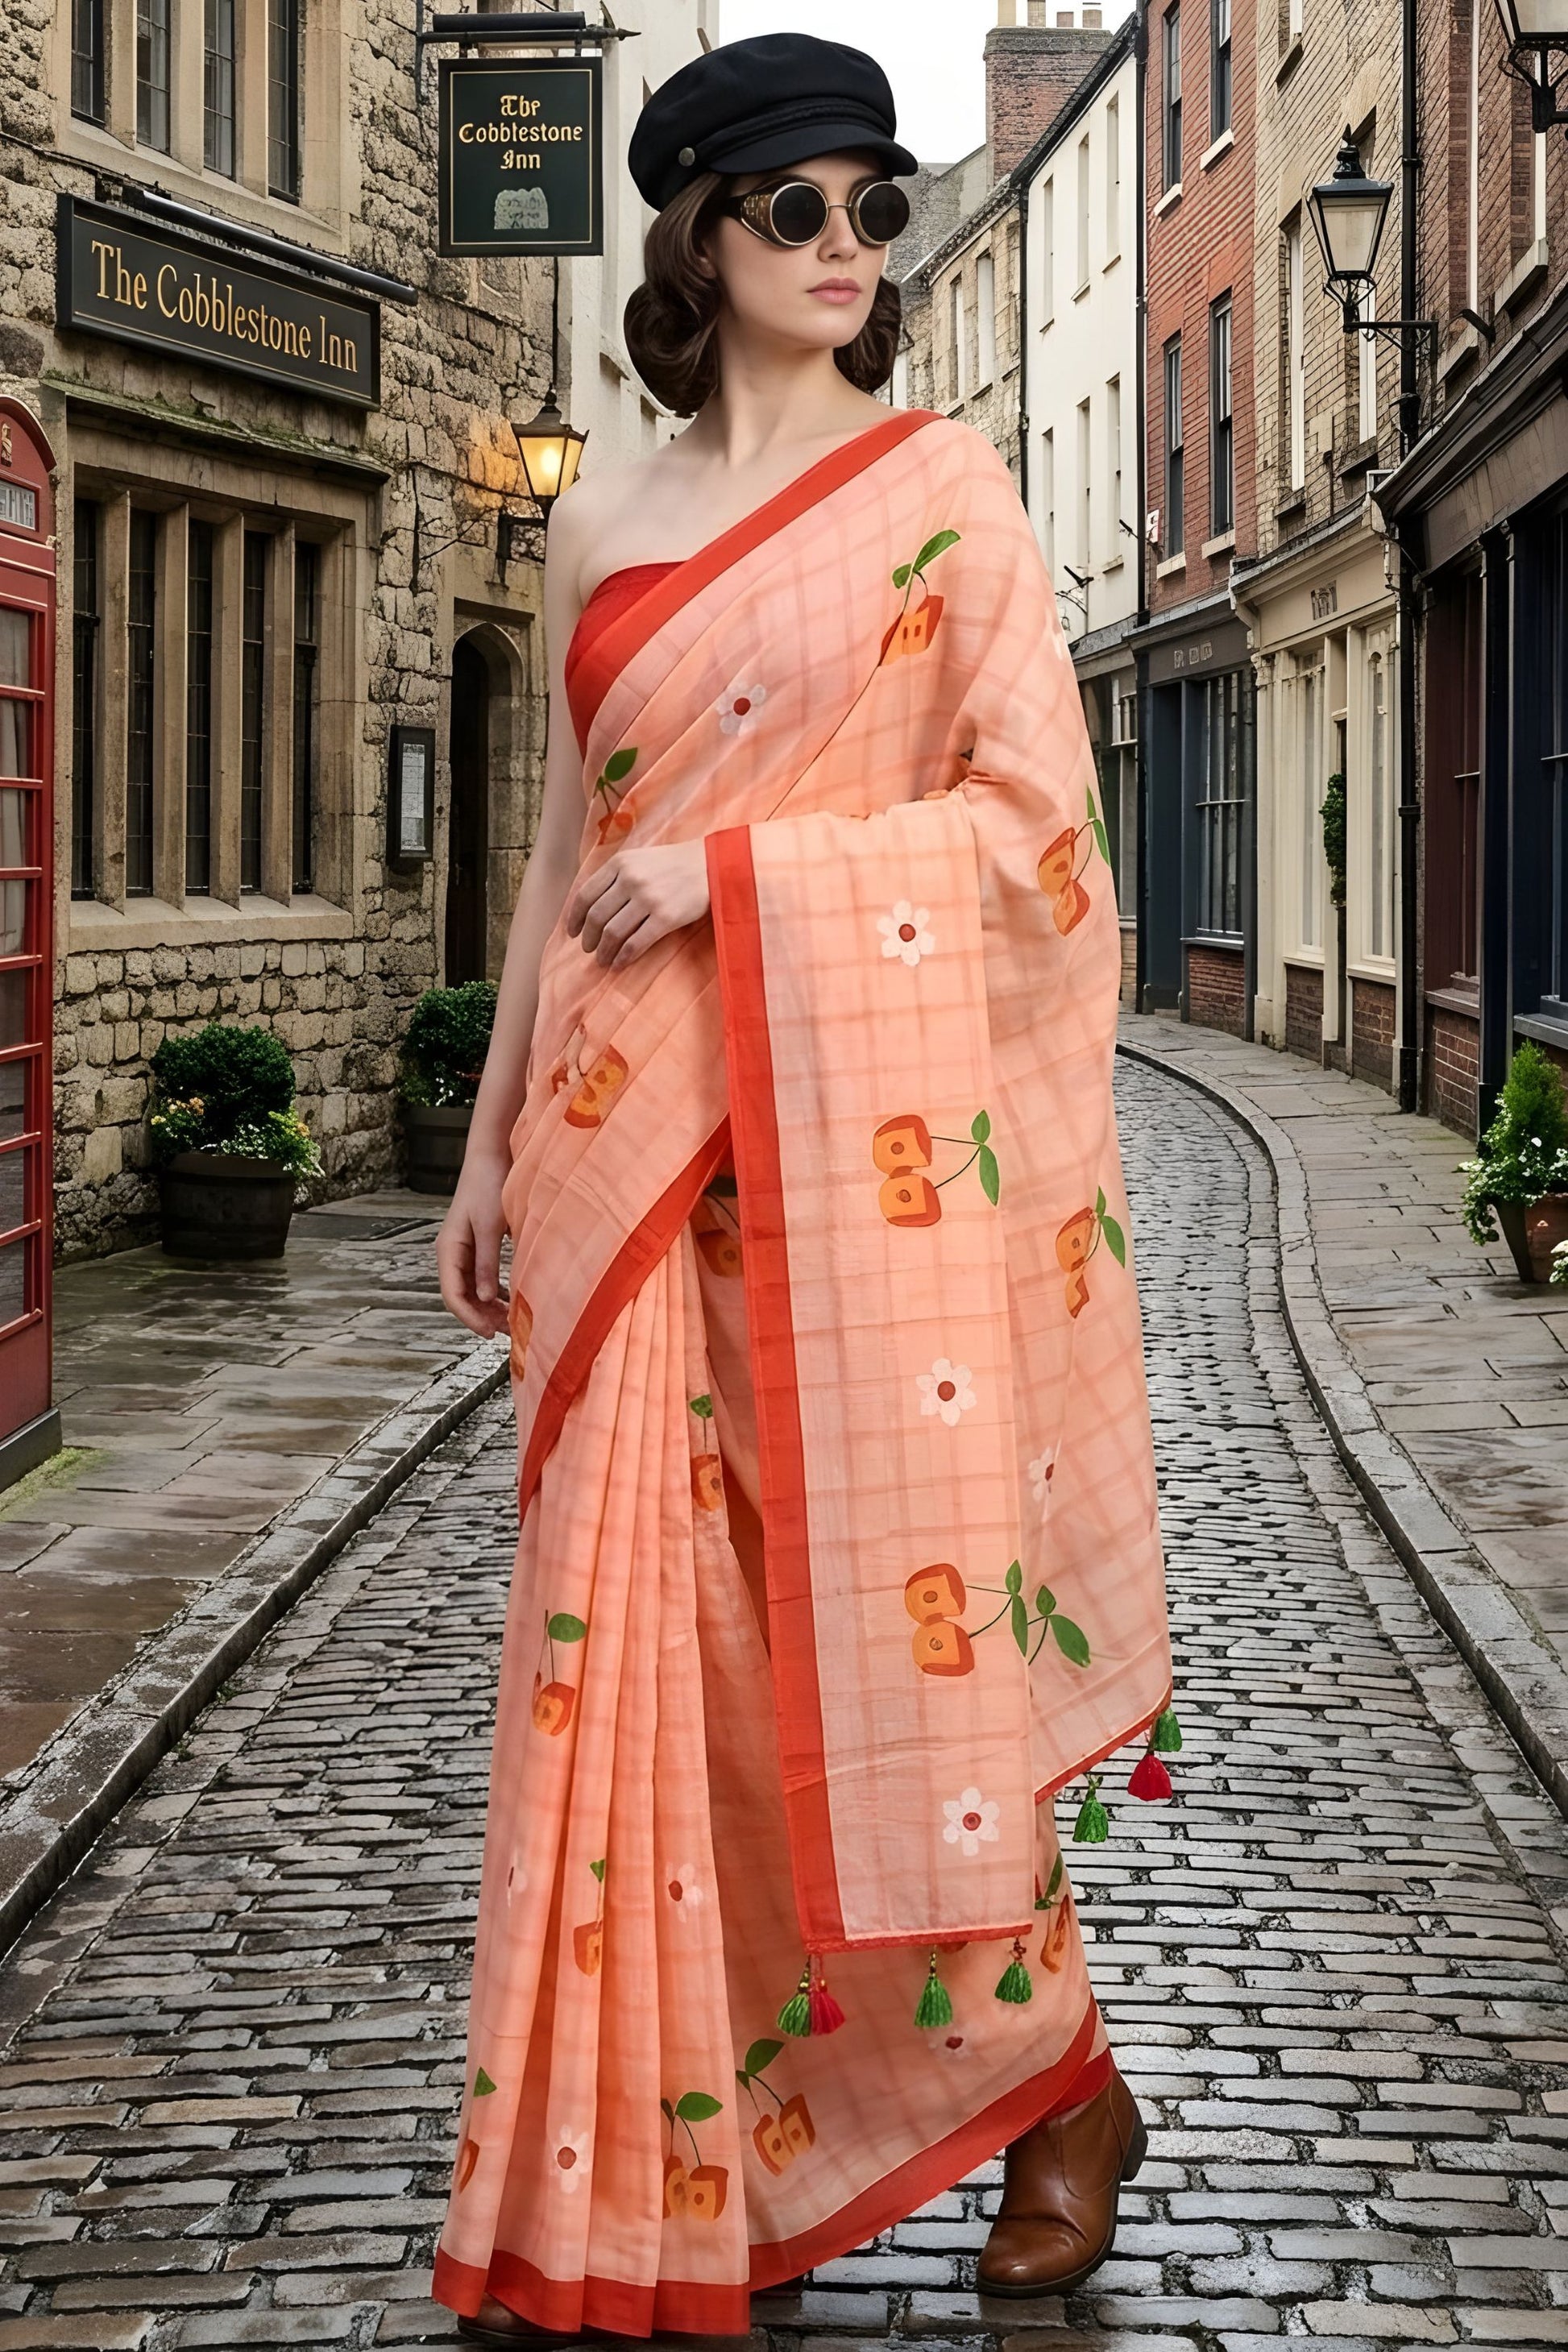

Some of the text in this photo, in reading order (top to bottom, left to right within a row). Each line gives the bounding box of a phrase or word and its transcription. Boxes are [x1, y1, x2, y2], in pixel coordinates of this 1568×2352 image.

[458, 122, 583, 143] Cobblestone
[500, 150, 541, 169] Inn
[92, 240, 358, 373] The Cobblestone Inn
